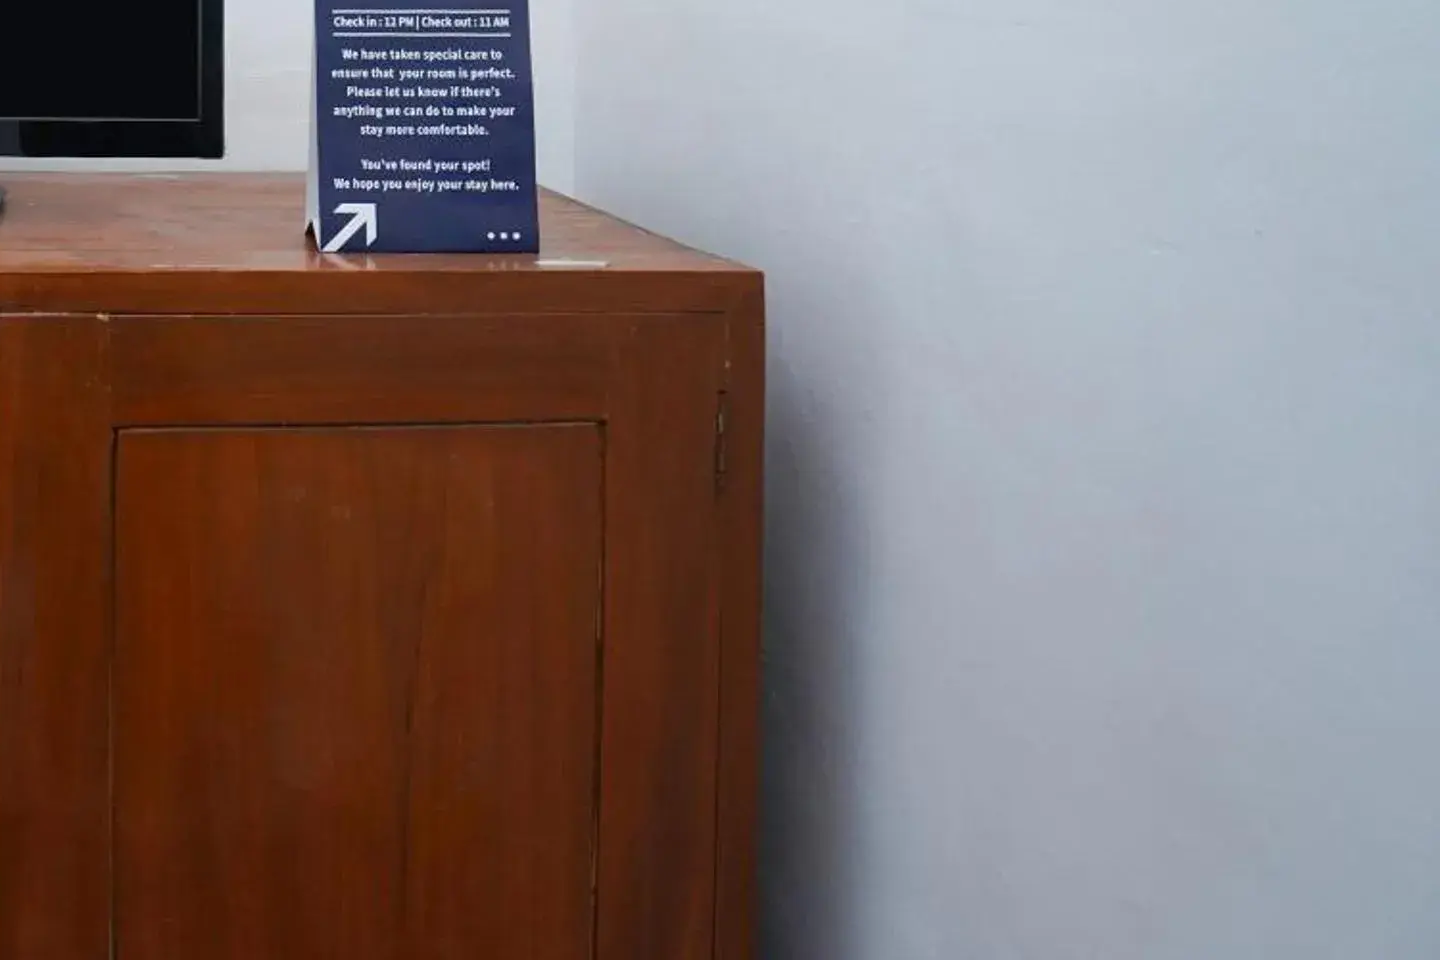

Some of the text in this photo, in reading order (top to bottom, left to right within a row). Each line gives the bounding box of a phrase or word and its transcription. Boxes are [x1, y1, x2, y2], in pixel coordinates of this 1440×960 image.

[333, 16, 364, 28] Check
[366, 16, 377, 28] in
[385, 17, 396, 28] 12
[398, 17, 414, 28] PM
[421, 17, 452, 28] Check
[454, 18, 472, 28] out
[479, 17, 492, 28] 11
[493, 17, 510, 28] AM
[341, 49, 503, 62] We have taken special care to
[331, 68, 516, 81] ensure that your room is perfect.
[346, 86, 500, 97] Please let us know if there's
[333, 106, 515, 118] anything we can do to make your
[360, 124, 489, 137] stay more comfortable.
[360, 159, 491, 173] You've found your spot!
[333, 178, 519, 192] We hope you enjoy your stay here.
